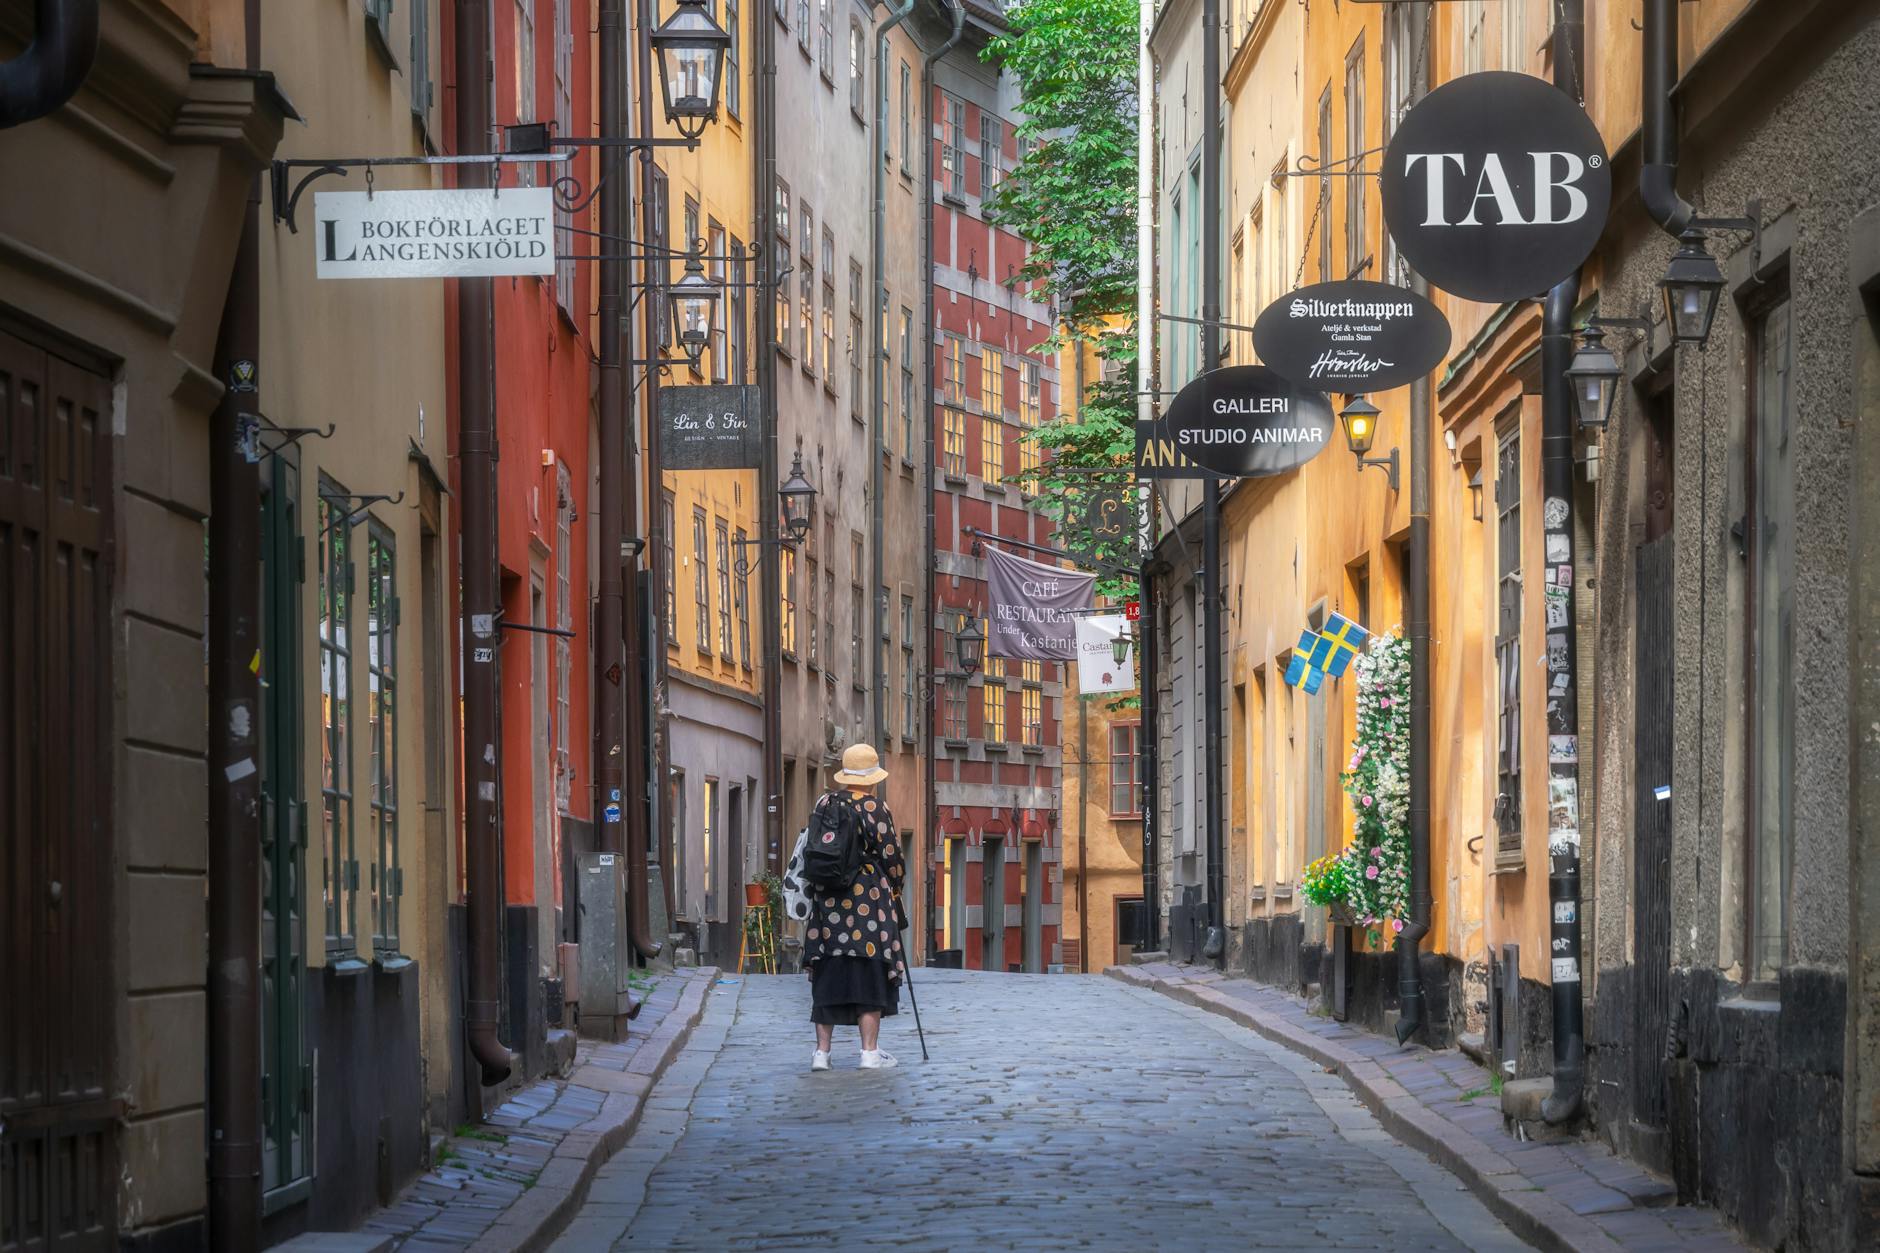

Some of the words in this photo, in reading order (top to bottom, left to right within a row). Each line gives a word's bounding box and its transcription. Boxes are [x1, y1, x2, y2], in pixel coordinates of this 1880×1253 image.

[360, 217, 546, 239] BOKFÖRLAGET
[1289, 298, 1414, 320] Silverknappen
[1321, 324, 1343, 333] Ateljé
[1343, 324, 1351, 332] &
[1352, 324, 1382, 332] verkstad
[1331, 333, 1355, 341] Gamla
[1355, 333, 1372, 341] Stan
[1212, 398, 1289, 414] GALLERI
[673, 413, 700, 430] Lin
[705, 413, 715, 429] &
[1178, 428, 1247, 444] STUDIO
[1251, 427, 1323, 443] ANIMAR
[1022, 578, 1060, 597] CAFÉ
[997, 623, 1021, 635] Under
